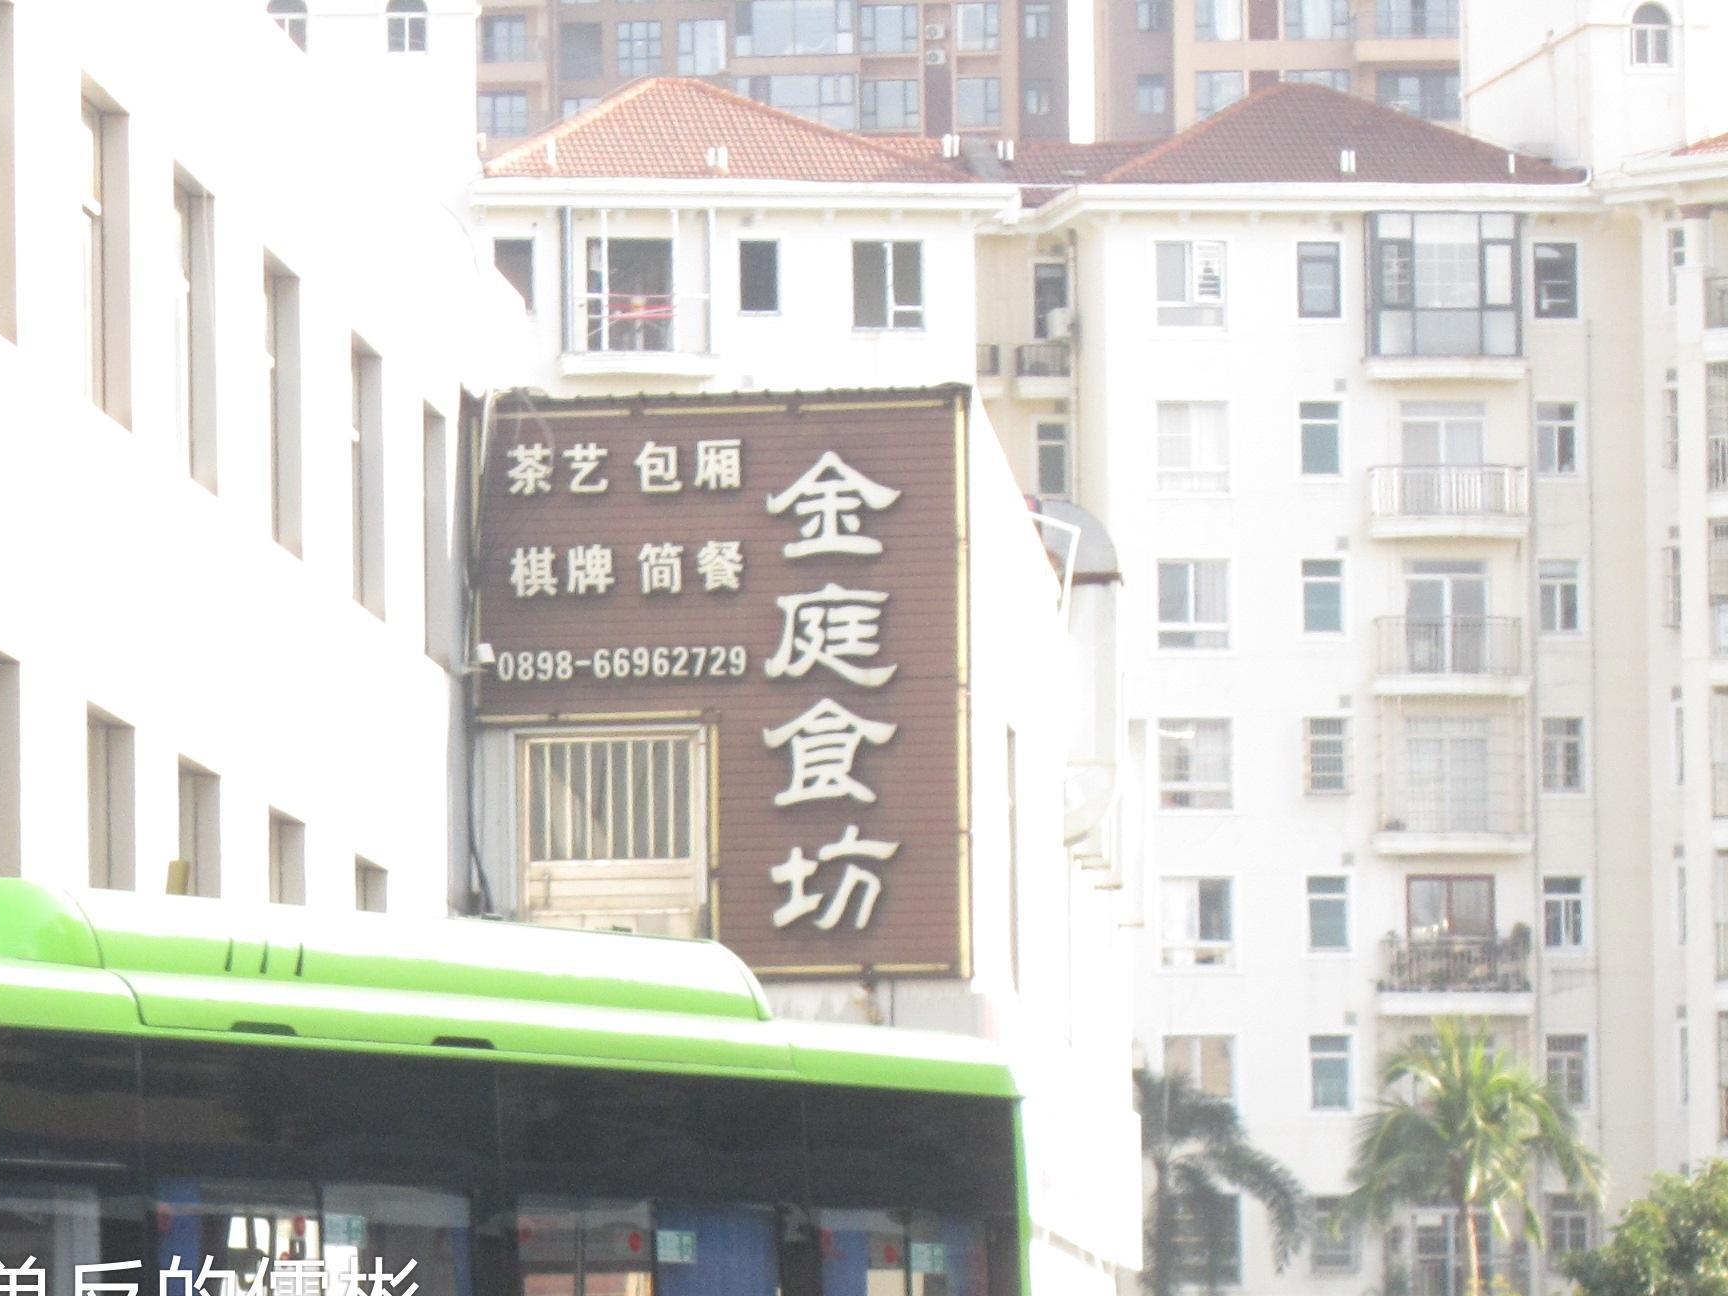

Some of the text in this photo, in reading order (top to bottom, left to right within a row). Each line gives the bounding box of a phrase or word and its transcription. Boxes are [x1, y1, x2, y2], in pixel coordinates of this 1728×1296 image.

[506, 438, 743, 496] 茶艺 包厢
[508, 540, 745, 598] 棋牌 简餐
[497, 644, 747, 682] 0898-66962729
[762, 450, 902, 931] 金庭食坊
